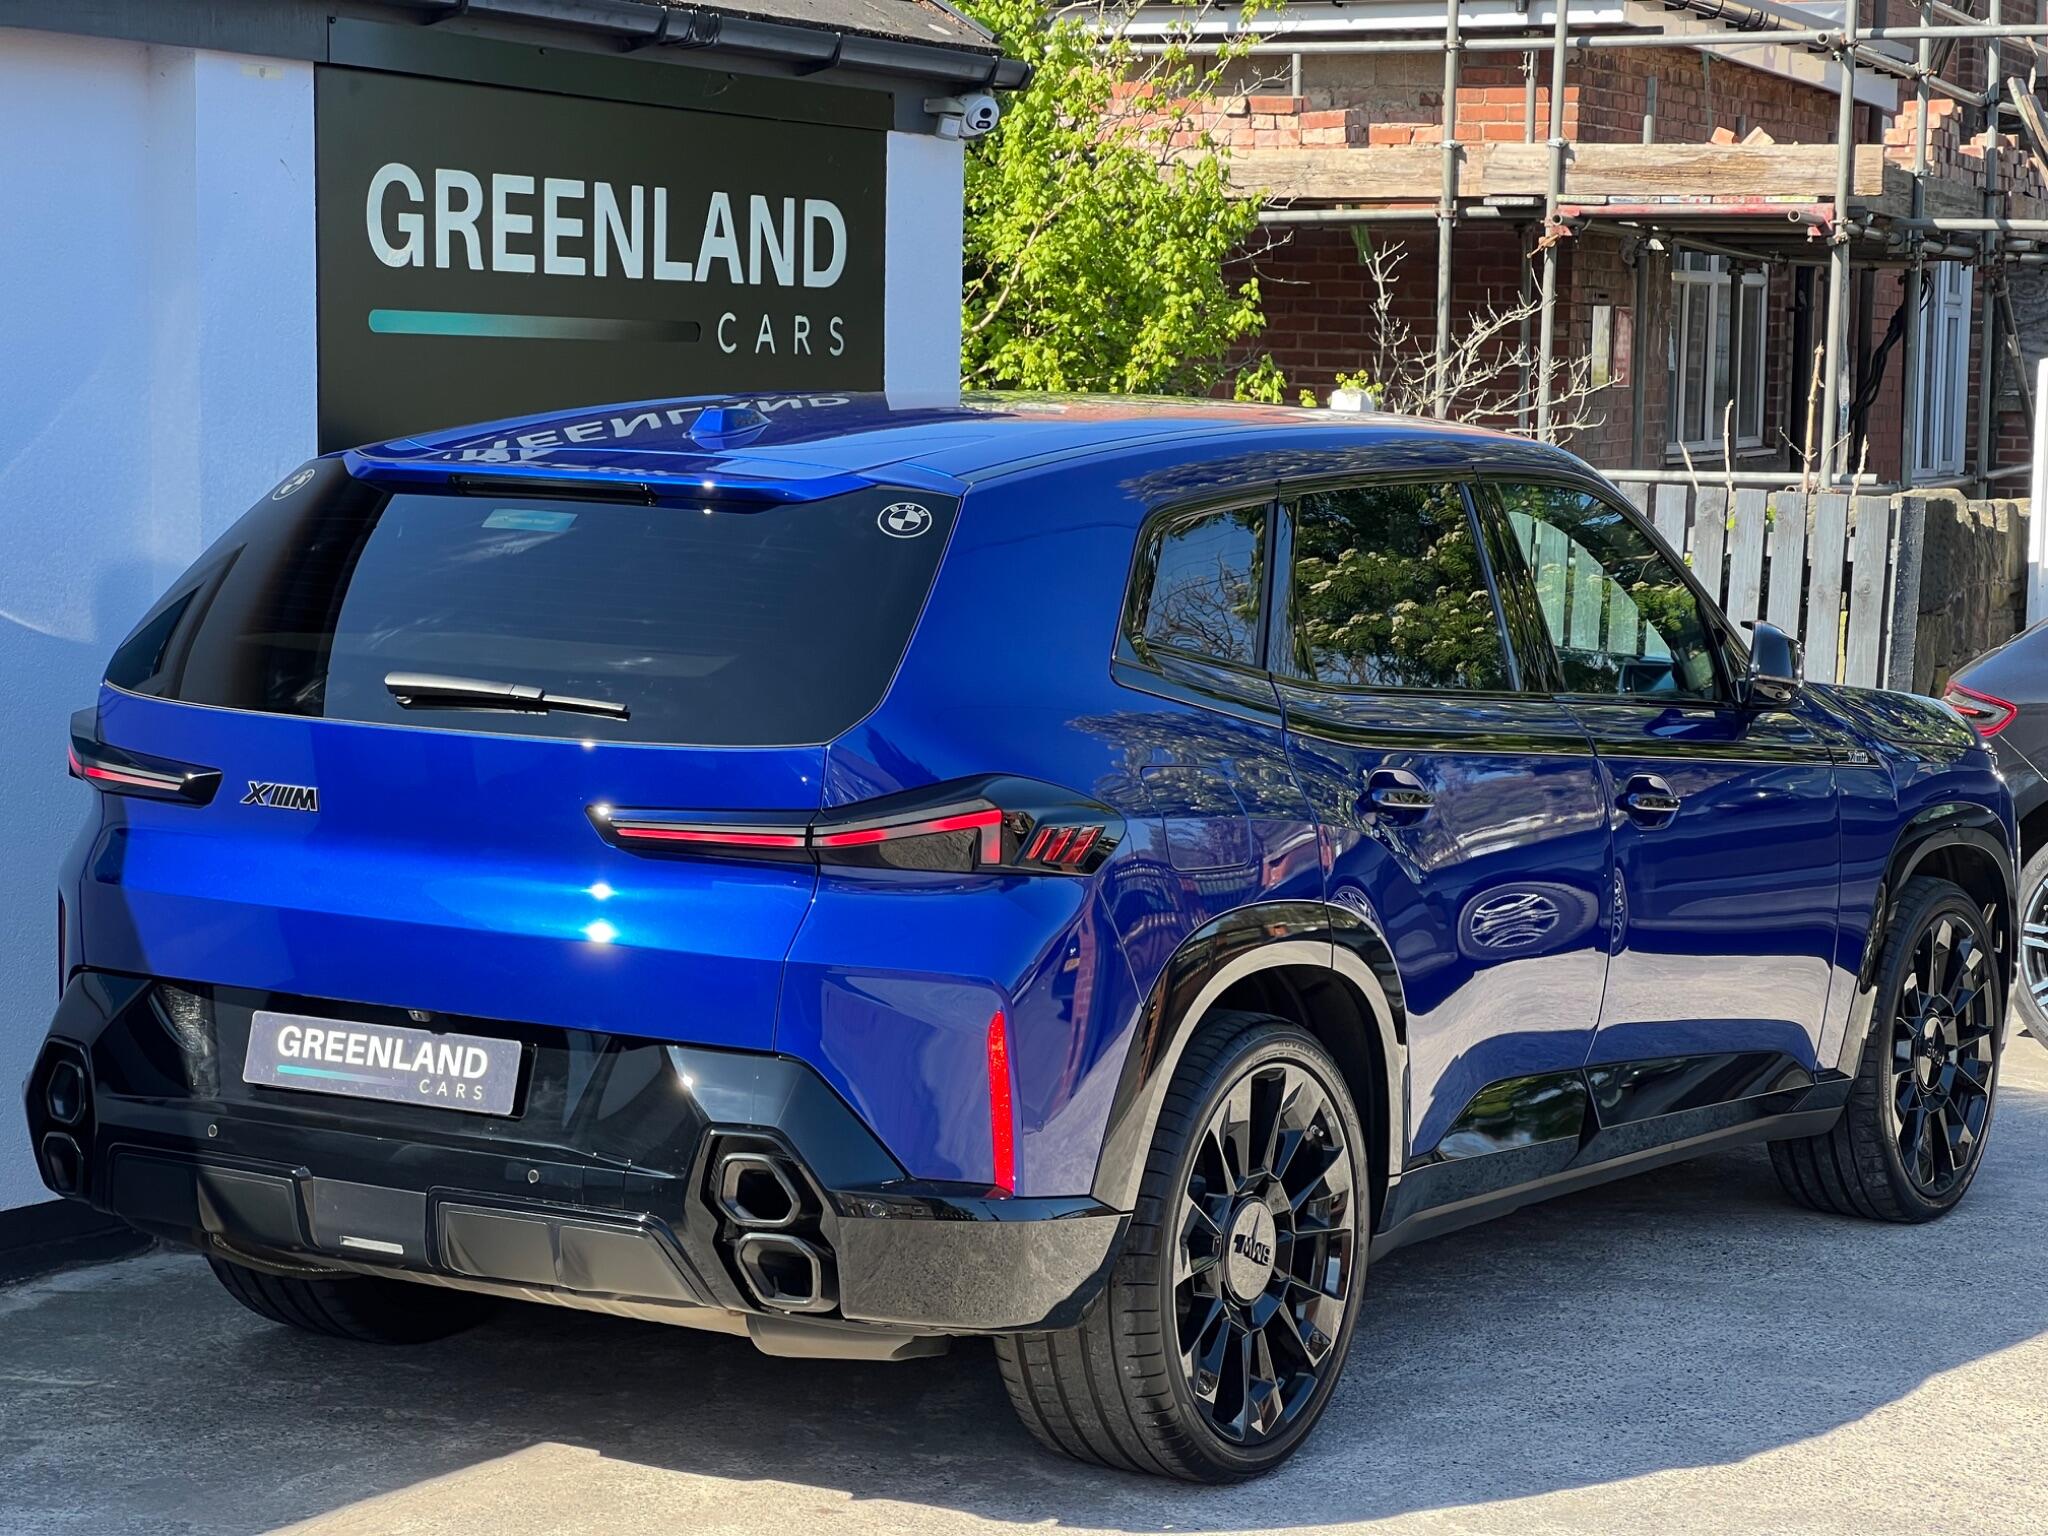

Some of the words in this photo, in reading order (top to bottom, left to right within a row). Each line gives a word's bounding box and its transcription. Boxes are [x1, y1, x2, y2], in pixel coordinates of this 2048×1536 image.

[366, 162, 847, 288] GREENLAND
[717, 312, 845, 356] CARS
[277, 1025, 488, 1079] GREENLAND
[419, 1079, 483, 1100] CARS
